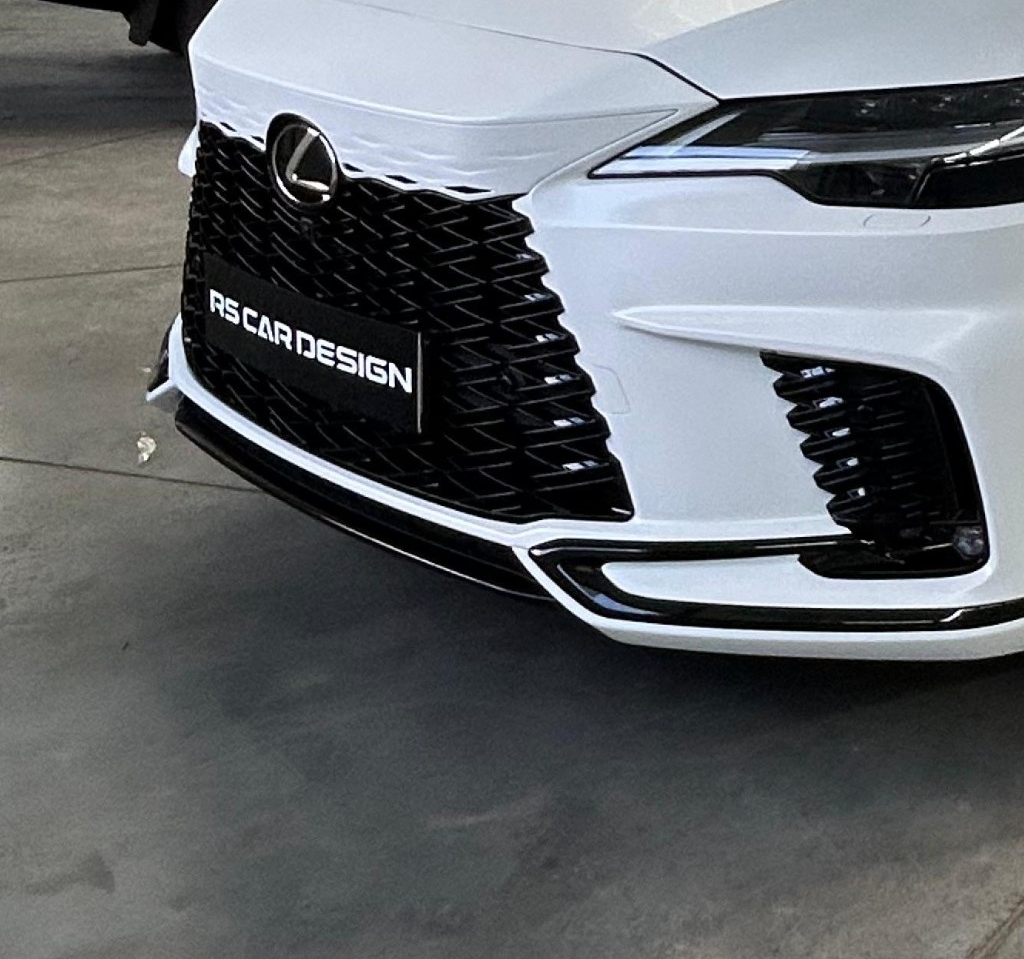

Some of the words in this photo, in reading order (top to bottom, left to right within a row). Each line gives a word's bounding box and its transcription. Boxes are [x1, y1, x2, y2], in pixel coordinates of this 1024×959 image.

[209, 288, 240, 325] RS
[242, 306, 293, 351] CAR
[295, 329, 413, 394] DESIGN
